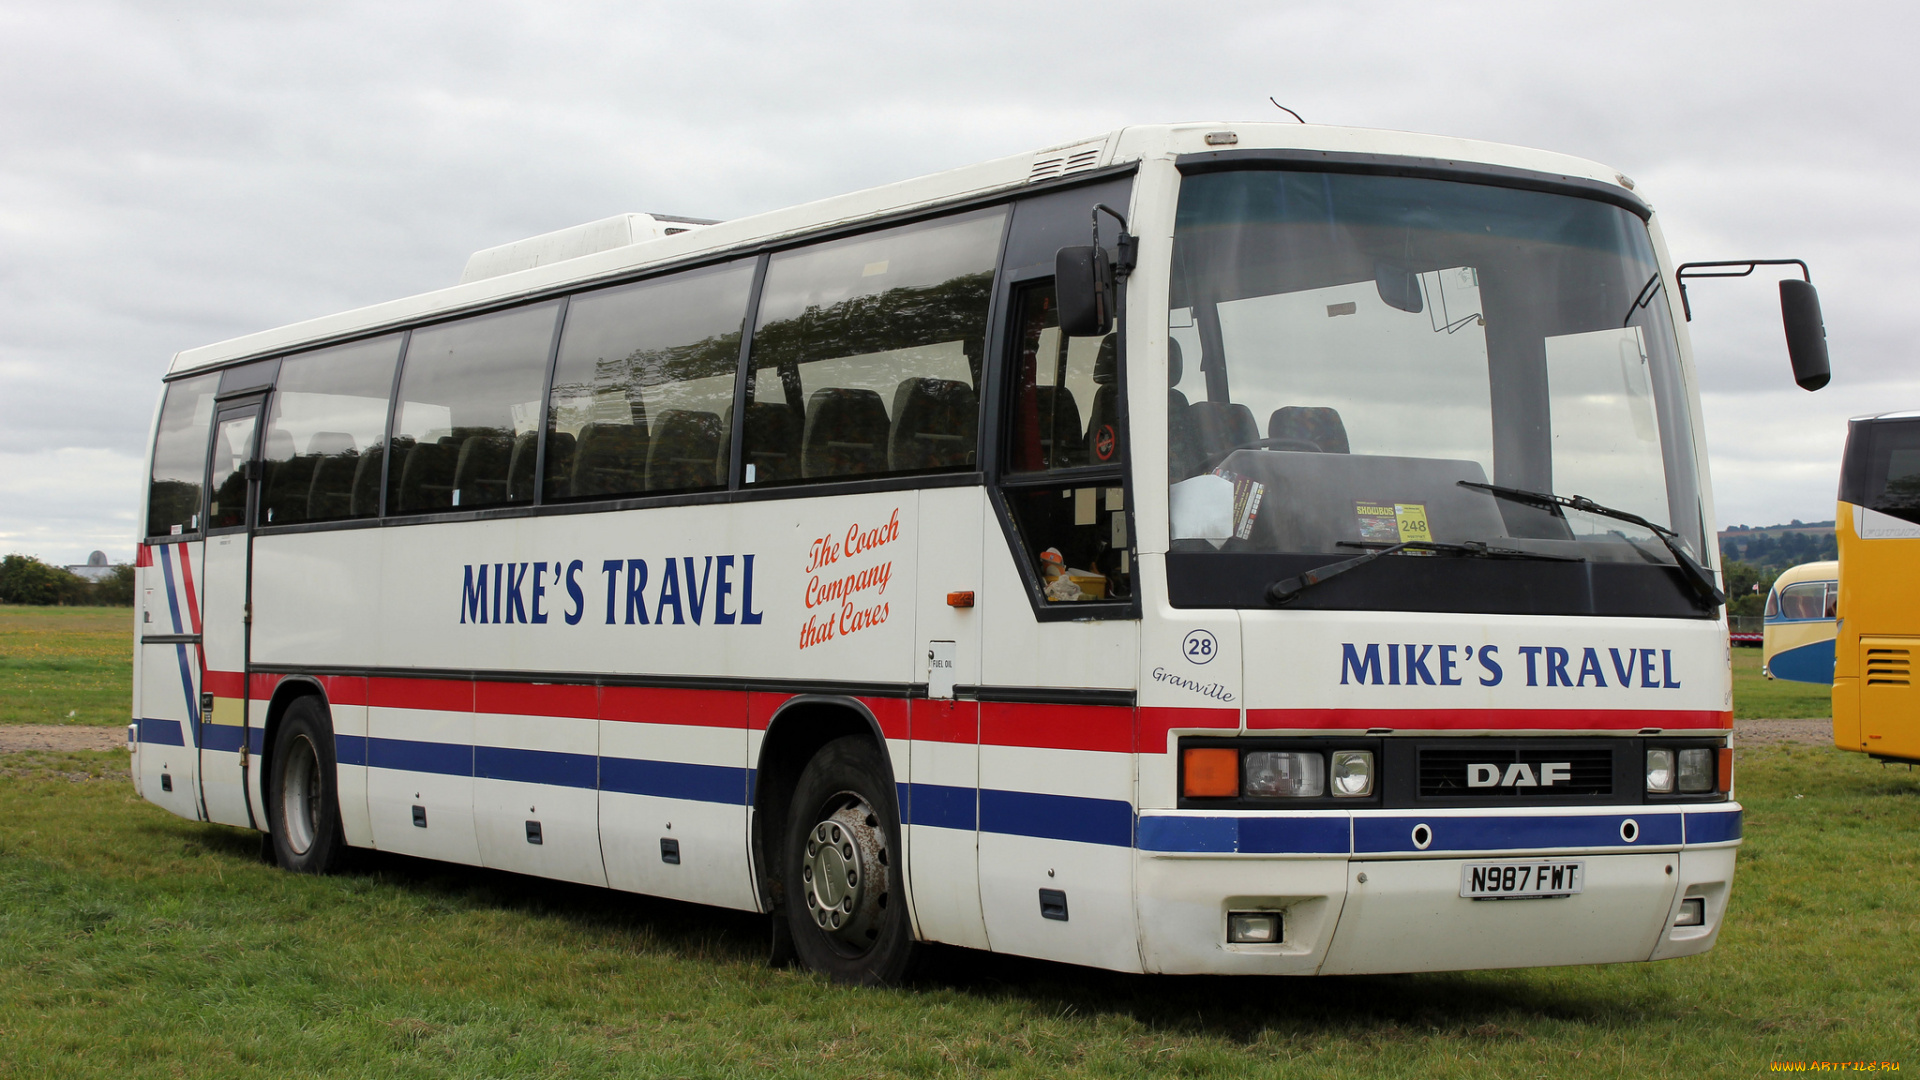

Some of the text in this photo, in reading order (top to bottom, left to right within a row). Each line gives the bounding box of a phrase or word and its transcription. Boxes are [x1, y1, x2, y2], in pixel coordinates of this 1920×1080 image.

[1356, 506, 1395, 516] SHOWBUS
[1401, 520, 1427, 532] 248
[805, 507, 900, 574] The Coach
[459, 553, 764, 627] MIKE'S TRAVEL
[805, 560, 893, 609] Company
[799, 601, 890, 651] that Cares
[1188, 638, 1212, 656] 28
[932, 660, 953, 668] FUEL OIL
[1339, 642, 1682, 689] MIKE'S TRAVEL
[1152, 666, 1236, 703] Granville
[1467, 762, 1571, 788] DAF
[1471, 864, 1579, 892] N987 FWT
